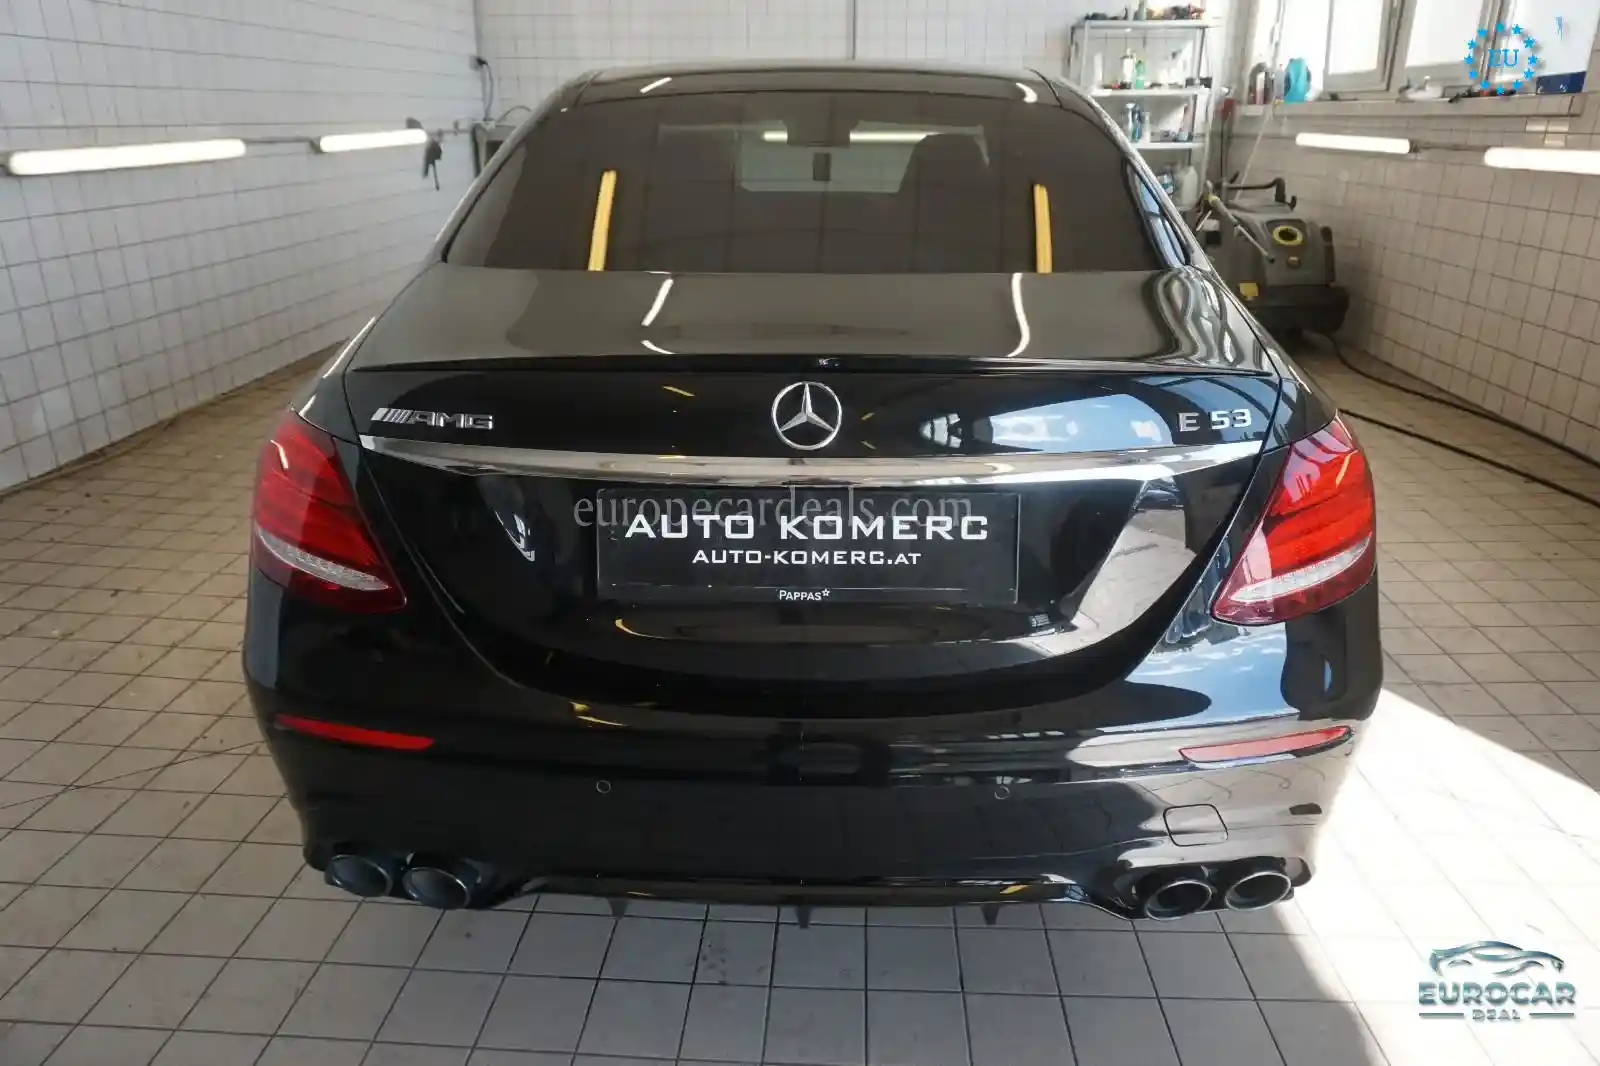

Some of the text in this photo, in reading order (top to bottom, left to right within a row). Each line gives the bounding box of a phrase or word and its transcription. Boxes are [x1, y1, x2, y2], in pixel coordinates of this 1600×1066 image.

[410, 410, 493, 430] AMG
[1179, 408, 1252, 432] E 53
[624, 514, 988, 540] AUTO KOMERC
[692, 549, 921, 565] AUTO-KOMERC.AT
[779, 589, 821, 601] PAPPAS
